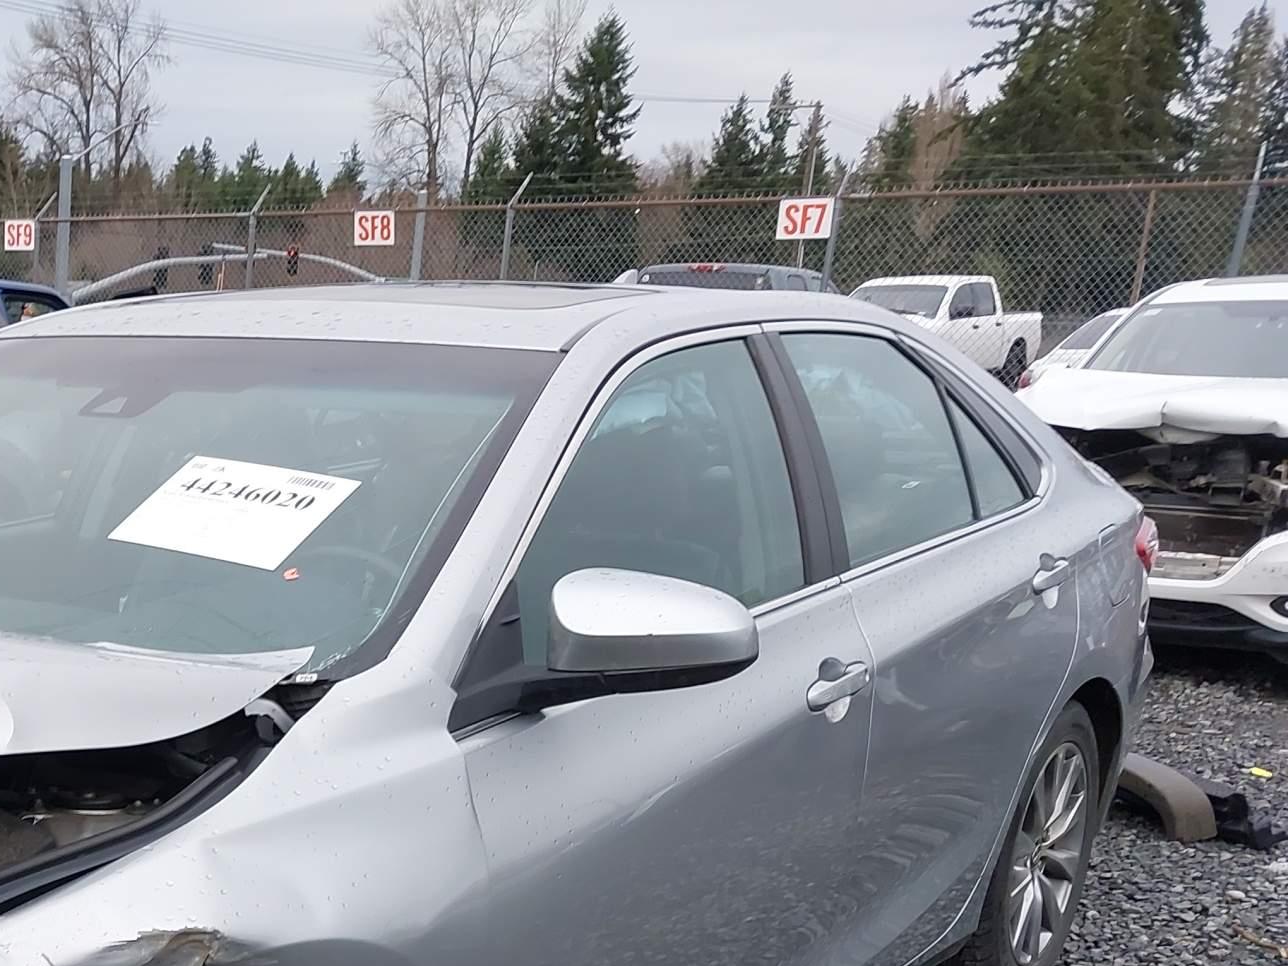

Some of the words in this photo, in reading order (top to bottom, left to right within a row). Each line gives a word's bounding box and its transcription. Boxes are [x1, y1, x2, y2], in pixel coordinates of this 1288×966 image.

[358, 215, 391, 241] SF8
[783, 203, 827, 235] SF7
[7, 223, 32, 247] SF9
[180, 476, 316, 511] 44246020
